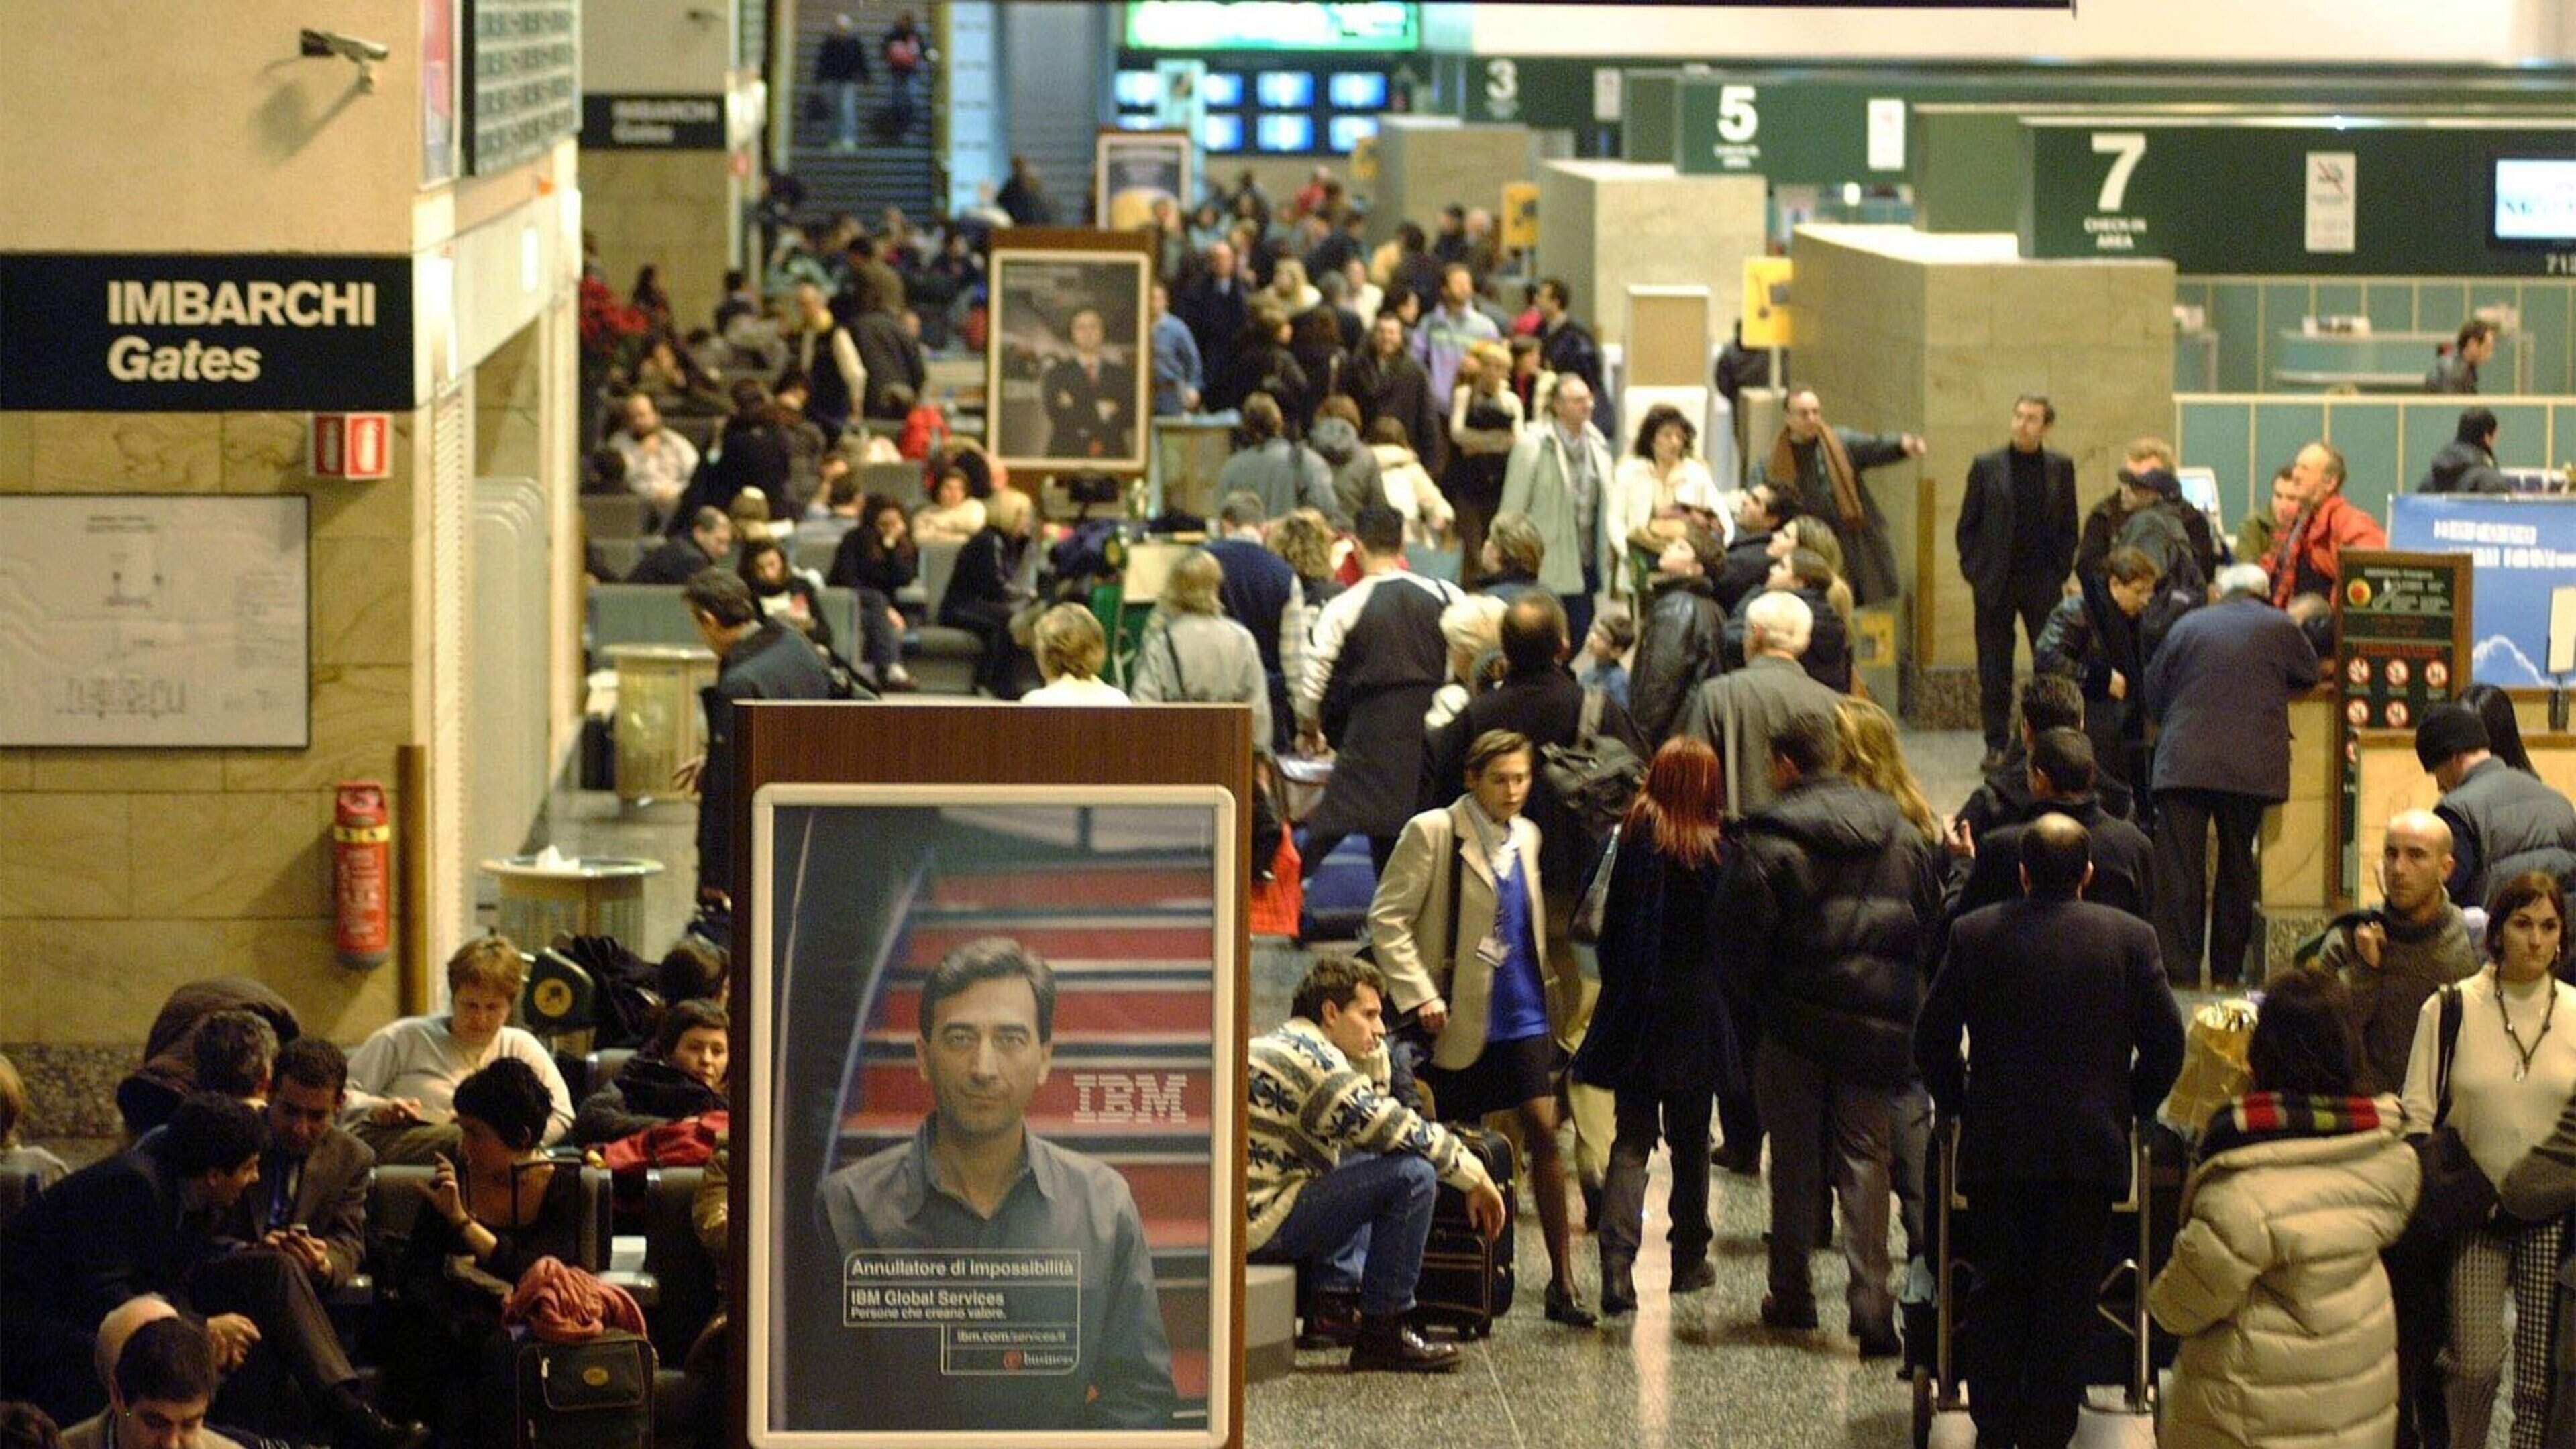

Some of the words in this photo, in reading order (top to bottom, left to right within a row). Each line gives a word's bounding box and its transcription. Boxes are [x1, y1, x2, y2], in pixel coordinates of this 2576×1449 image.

[1486, 60, 1519, 99] 3
[1717, 85, 1758, 142] 5
[2091, 133, 2147, 212] 7
[107, 280, 377, 327] IMBARCHI
[107, 335, 262, 382] Gates
[1073, 1073, 1187, 1123] IBM
[851, 1258, 947, 1276] Annullatore
[949, 1258, 966, 1276] di
[851, 1289, 881, 1306] IBM
[884, 1289, 934, 1307] Global
[938, 1289, 1005, 1307] Services
[901, 1307, 923, 1320] che
